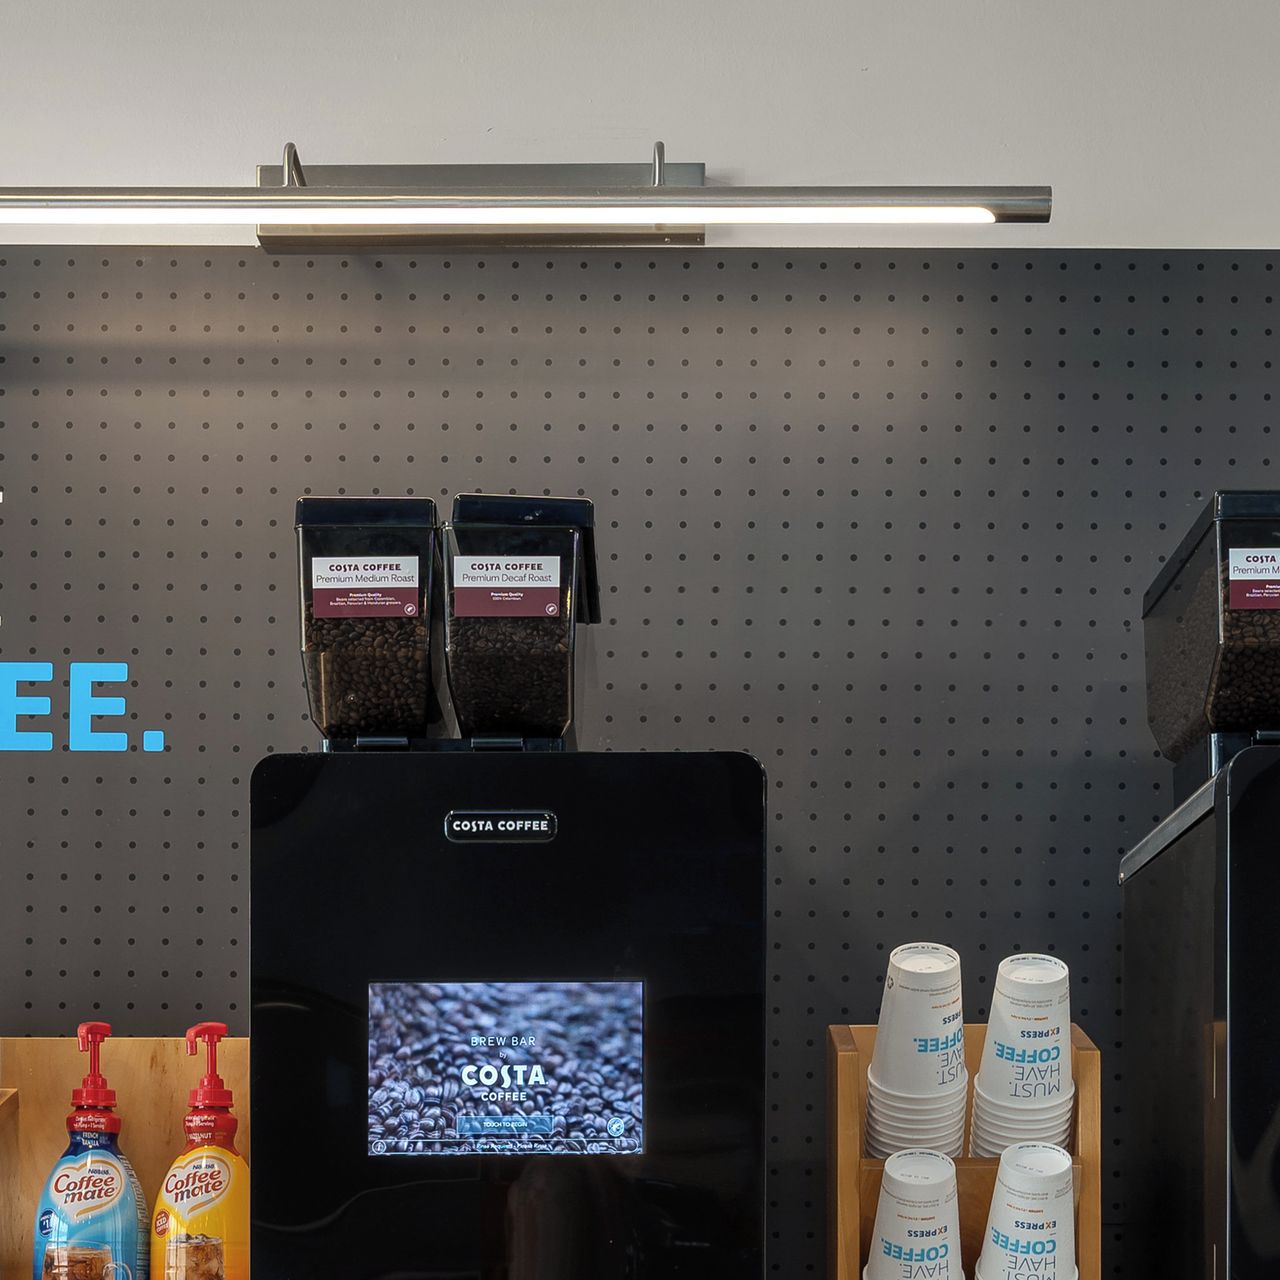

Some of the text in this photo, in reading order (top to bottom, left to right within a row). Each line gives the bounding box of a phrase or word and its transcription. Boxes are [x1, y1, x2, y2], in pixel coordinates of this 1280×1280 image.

[329, 564, 402, 572] COSTA COFFEE
[471, 564, 502, 572] COSTA
[1246, 556, 1276, 564] COSTA
[316, 574, 415, 584] Premium Medium Roast
[462, 574, 552, 582] Premium Decaf Roast
[1232, 566, 1270, 574] Premium
[452, 820, 548, 832] COSTA COFFEE
[471, 1036, 536, 1046] BREW BAR
[913, 1027, 963, 1053] OFFEE.
[1020, 1026, 1060, 1038] EXPRESS
[937, 1048, 963, 1068] AVE.
[994, 1041, 1060, 1064] COFFEE.
[462, 1064, 546, 1088] COSTA
[936, 1064, 964, 1086] UST.
[1012, 1062, 1060, 1081] HAVE.
[481, 1092, 527, 1101] COFFEE
[1009, 1078, 1060, 1098] MUST.
[54, 1174, 115, 1194] Coffee
[165, 1170, 221, 1193] Coffee
[64, 1186, 115, 1204] mate
[174, 1180, 223, 1203] mate
[907, 1225, 948, 1238] EXPRESS
[1014, 1220, 1056, 1230] EXPRESS
[880, 1237, 948, 1262] COFFEE.
[991, 1226, 1056, 1255] COFFEE.
[899, 1260, 948, 1279] HAVE.
[1005, 1253, 1056, 1271] HAVE.
